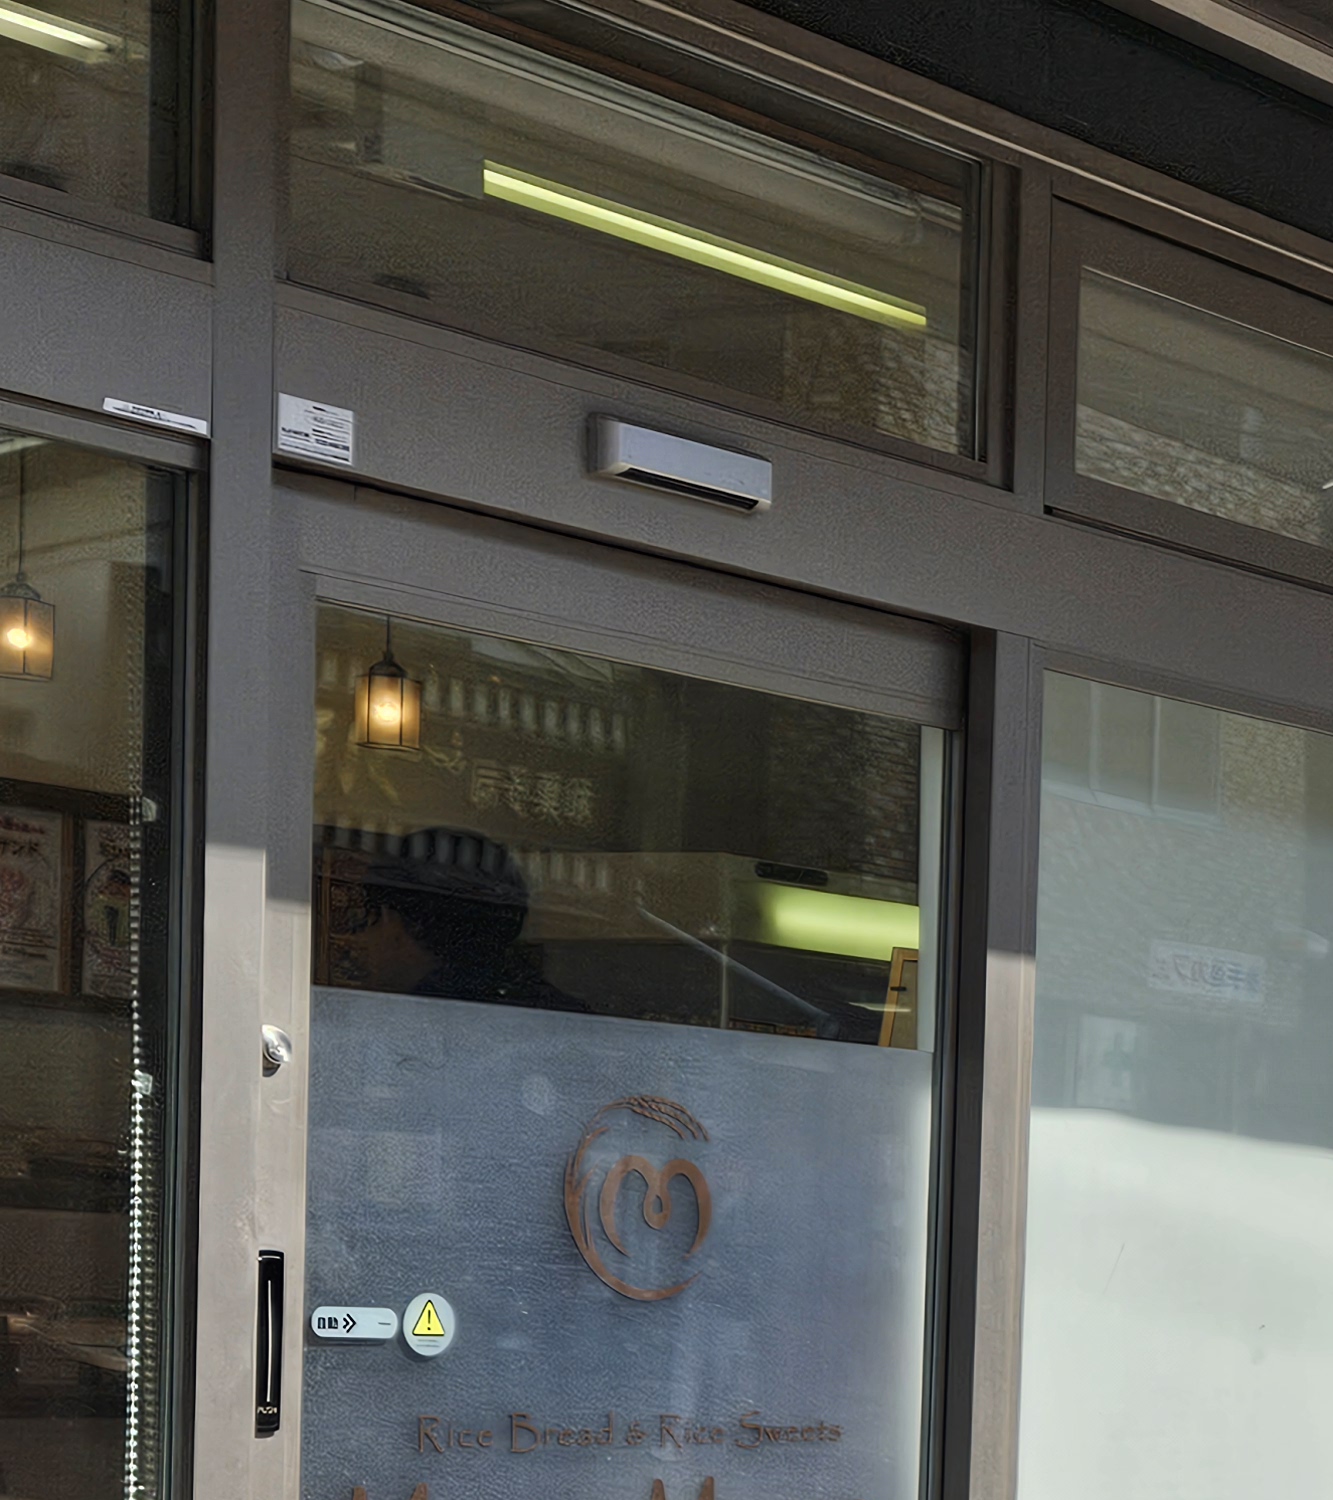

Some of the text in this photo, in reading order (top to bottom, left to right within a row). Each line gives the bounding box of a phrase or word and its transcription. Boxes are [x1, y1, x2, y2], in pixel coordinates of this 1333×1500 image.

[418, 1414, 494, 1453] Rice
[508, 1411, 614, 1453] Bread
[659, 1413, 725, 1449] Rice
[734, 1410, 844, 1449] Sweets
